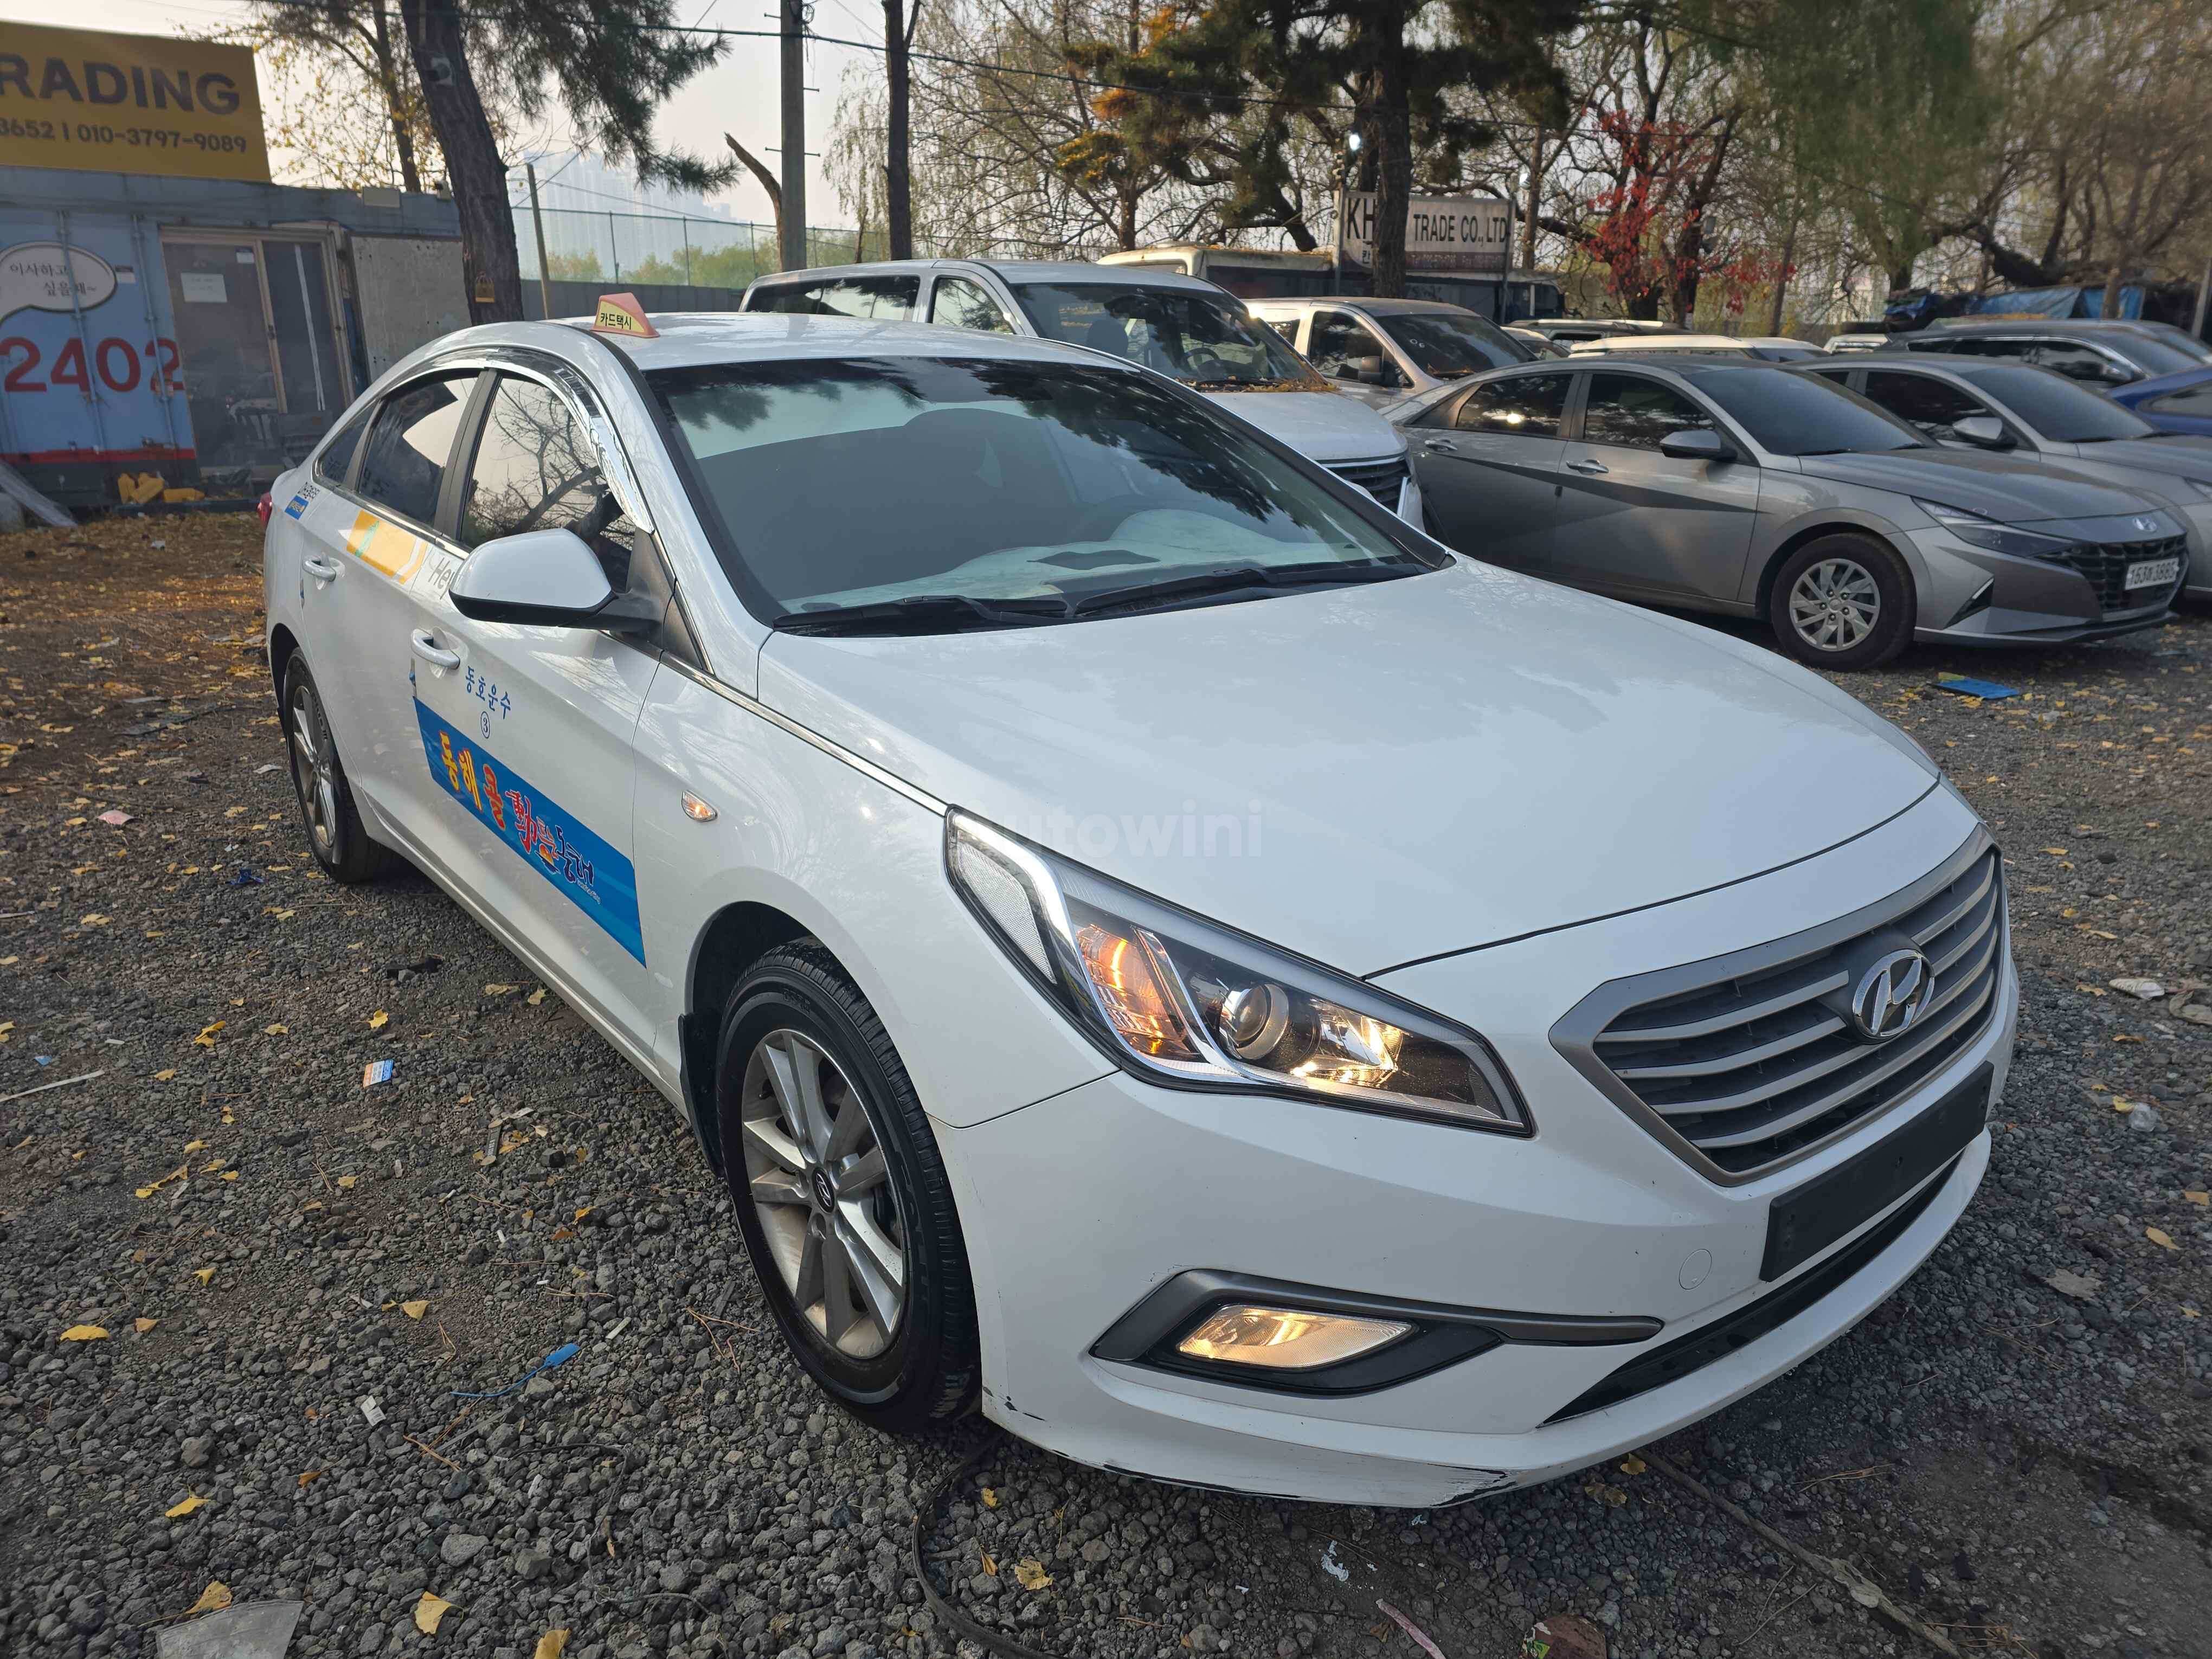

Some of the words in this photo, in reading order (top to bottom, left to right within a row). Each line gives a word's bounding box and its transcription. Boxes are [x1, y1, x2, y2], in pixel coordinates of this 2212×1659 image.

[78, 124, 247, 153] 010-3797-9089
[1413, 214, 1456, 242] TRADE
[600, 312, 632, 330] 카드택시
[465, 665, 511, 720] 동호운수
